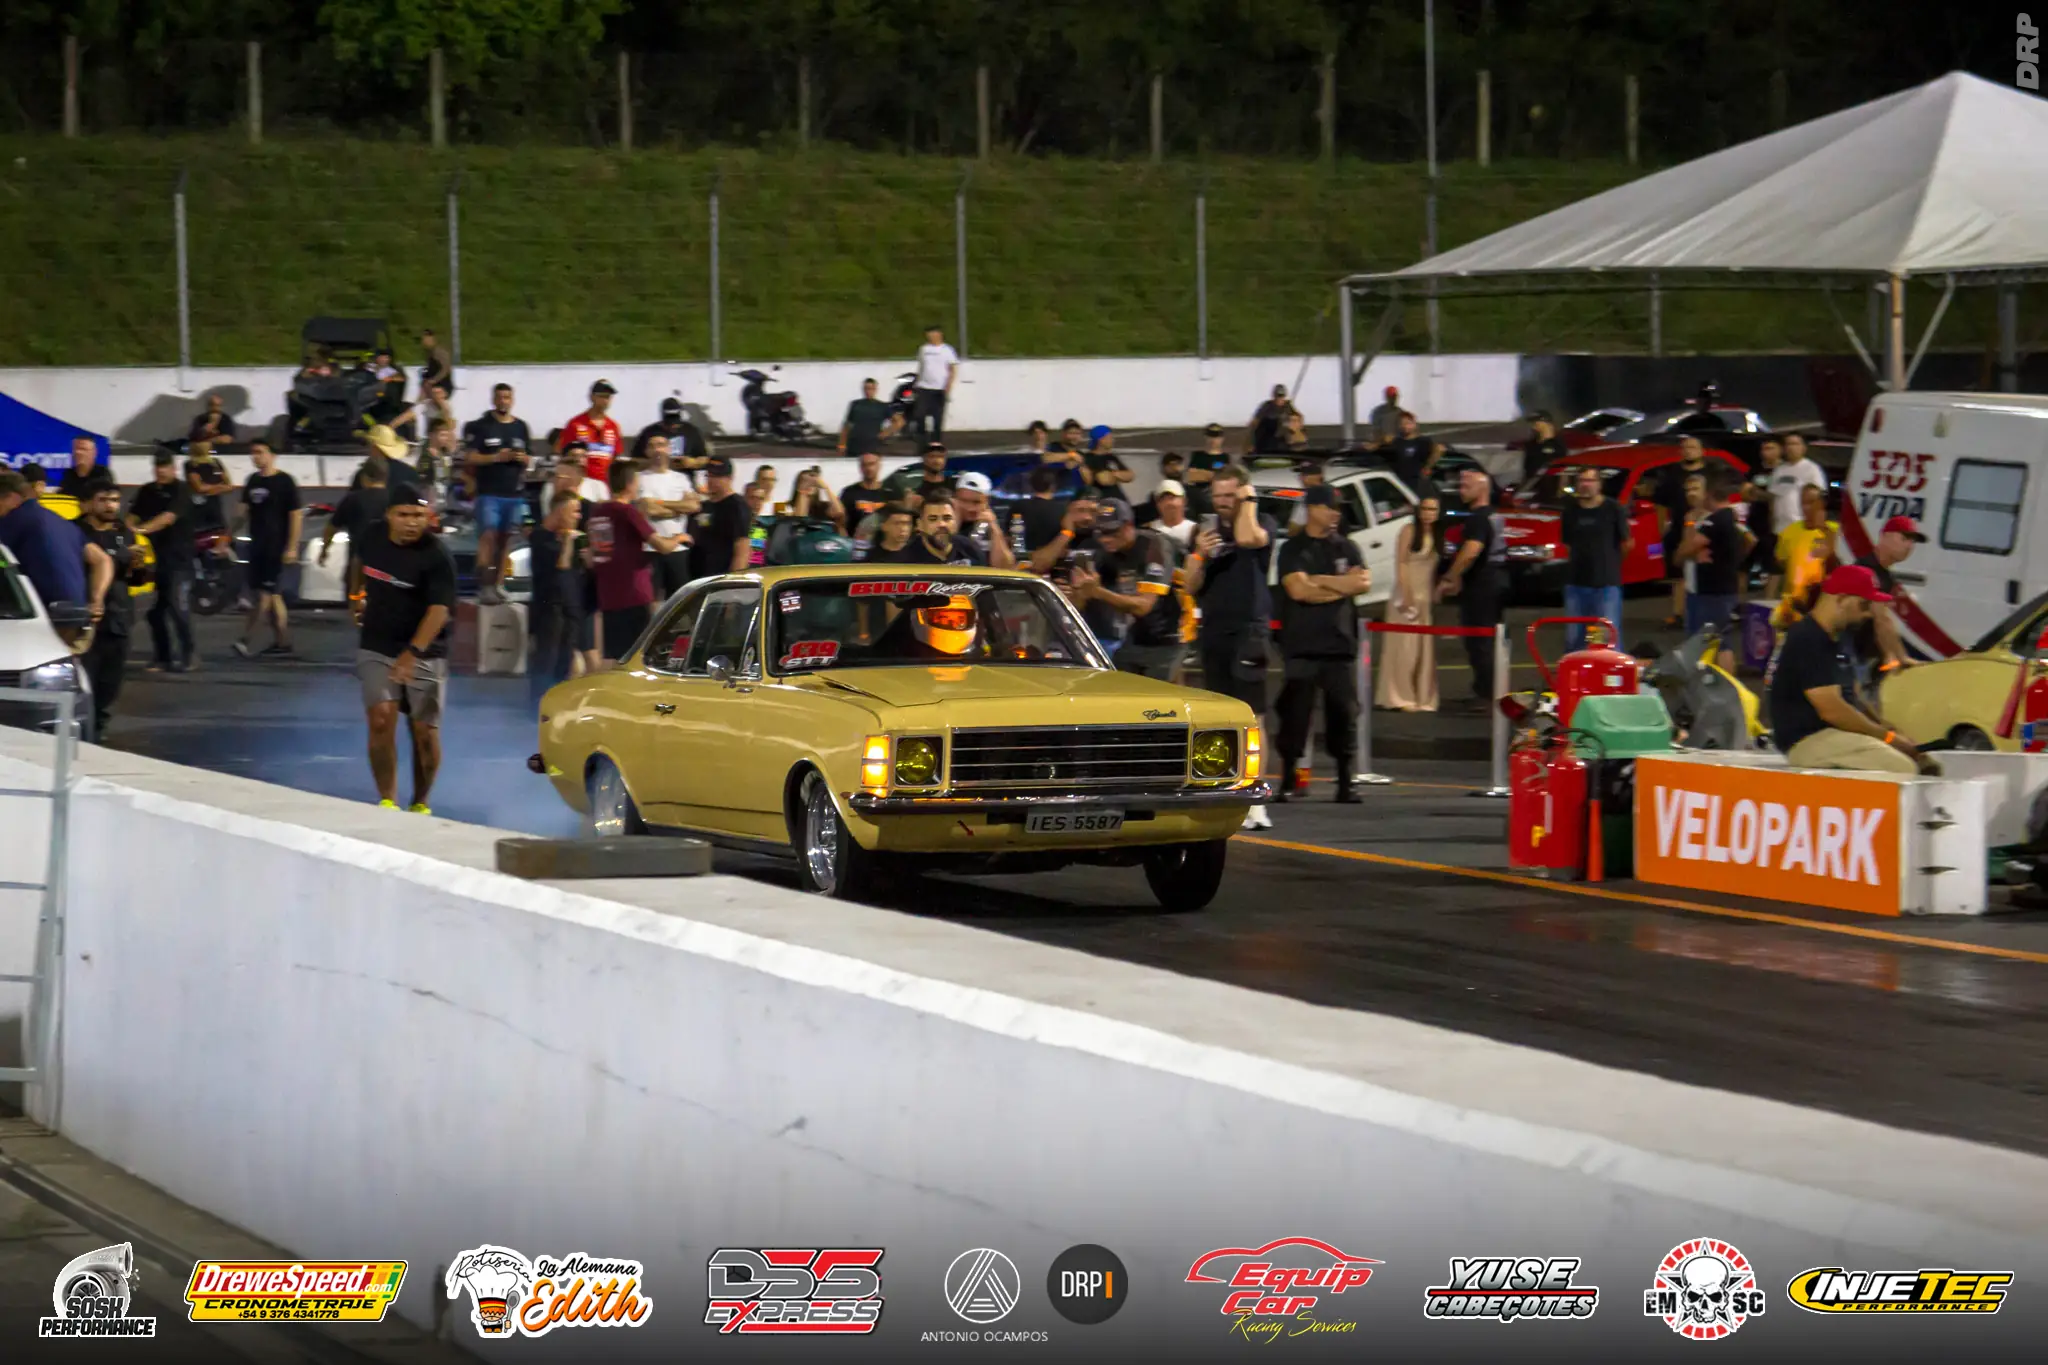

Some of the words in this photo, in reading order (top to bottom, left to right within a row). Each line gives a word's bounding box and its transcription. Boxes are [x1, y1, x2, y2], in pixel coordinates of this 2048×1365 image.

[1859, 492, 1927, 522] VIDA
[848, 581, 932, 596] BILLA
[1653, 785, 1886, 886] VELOPARK
